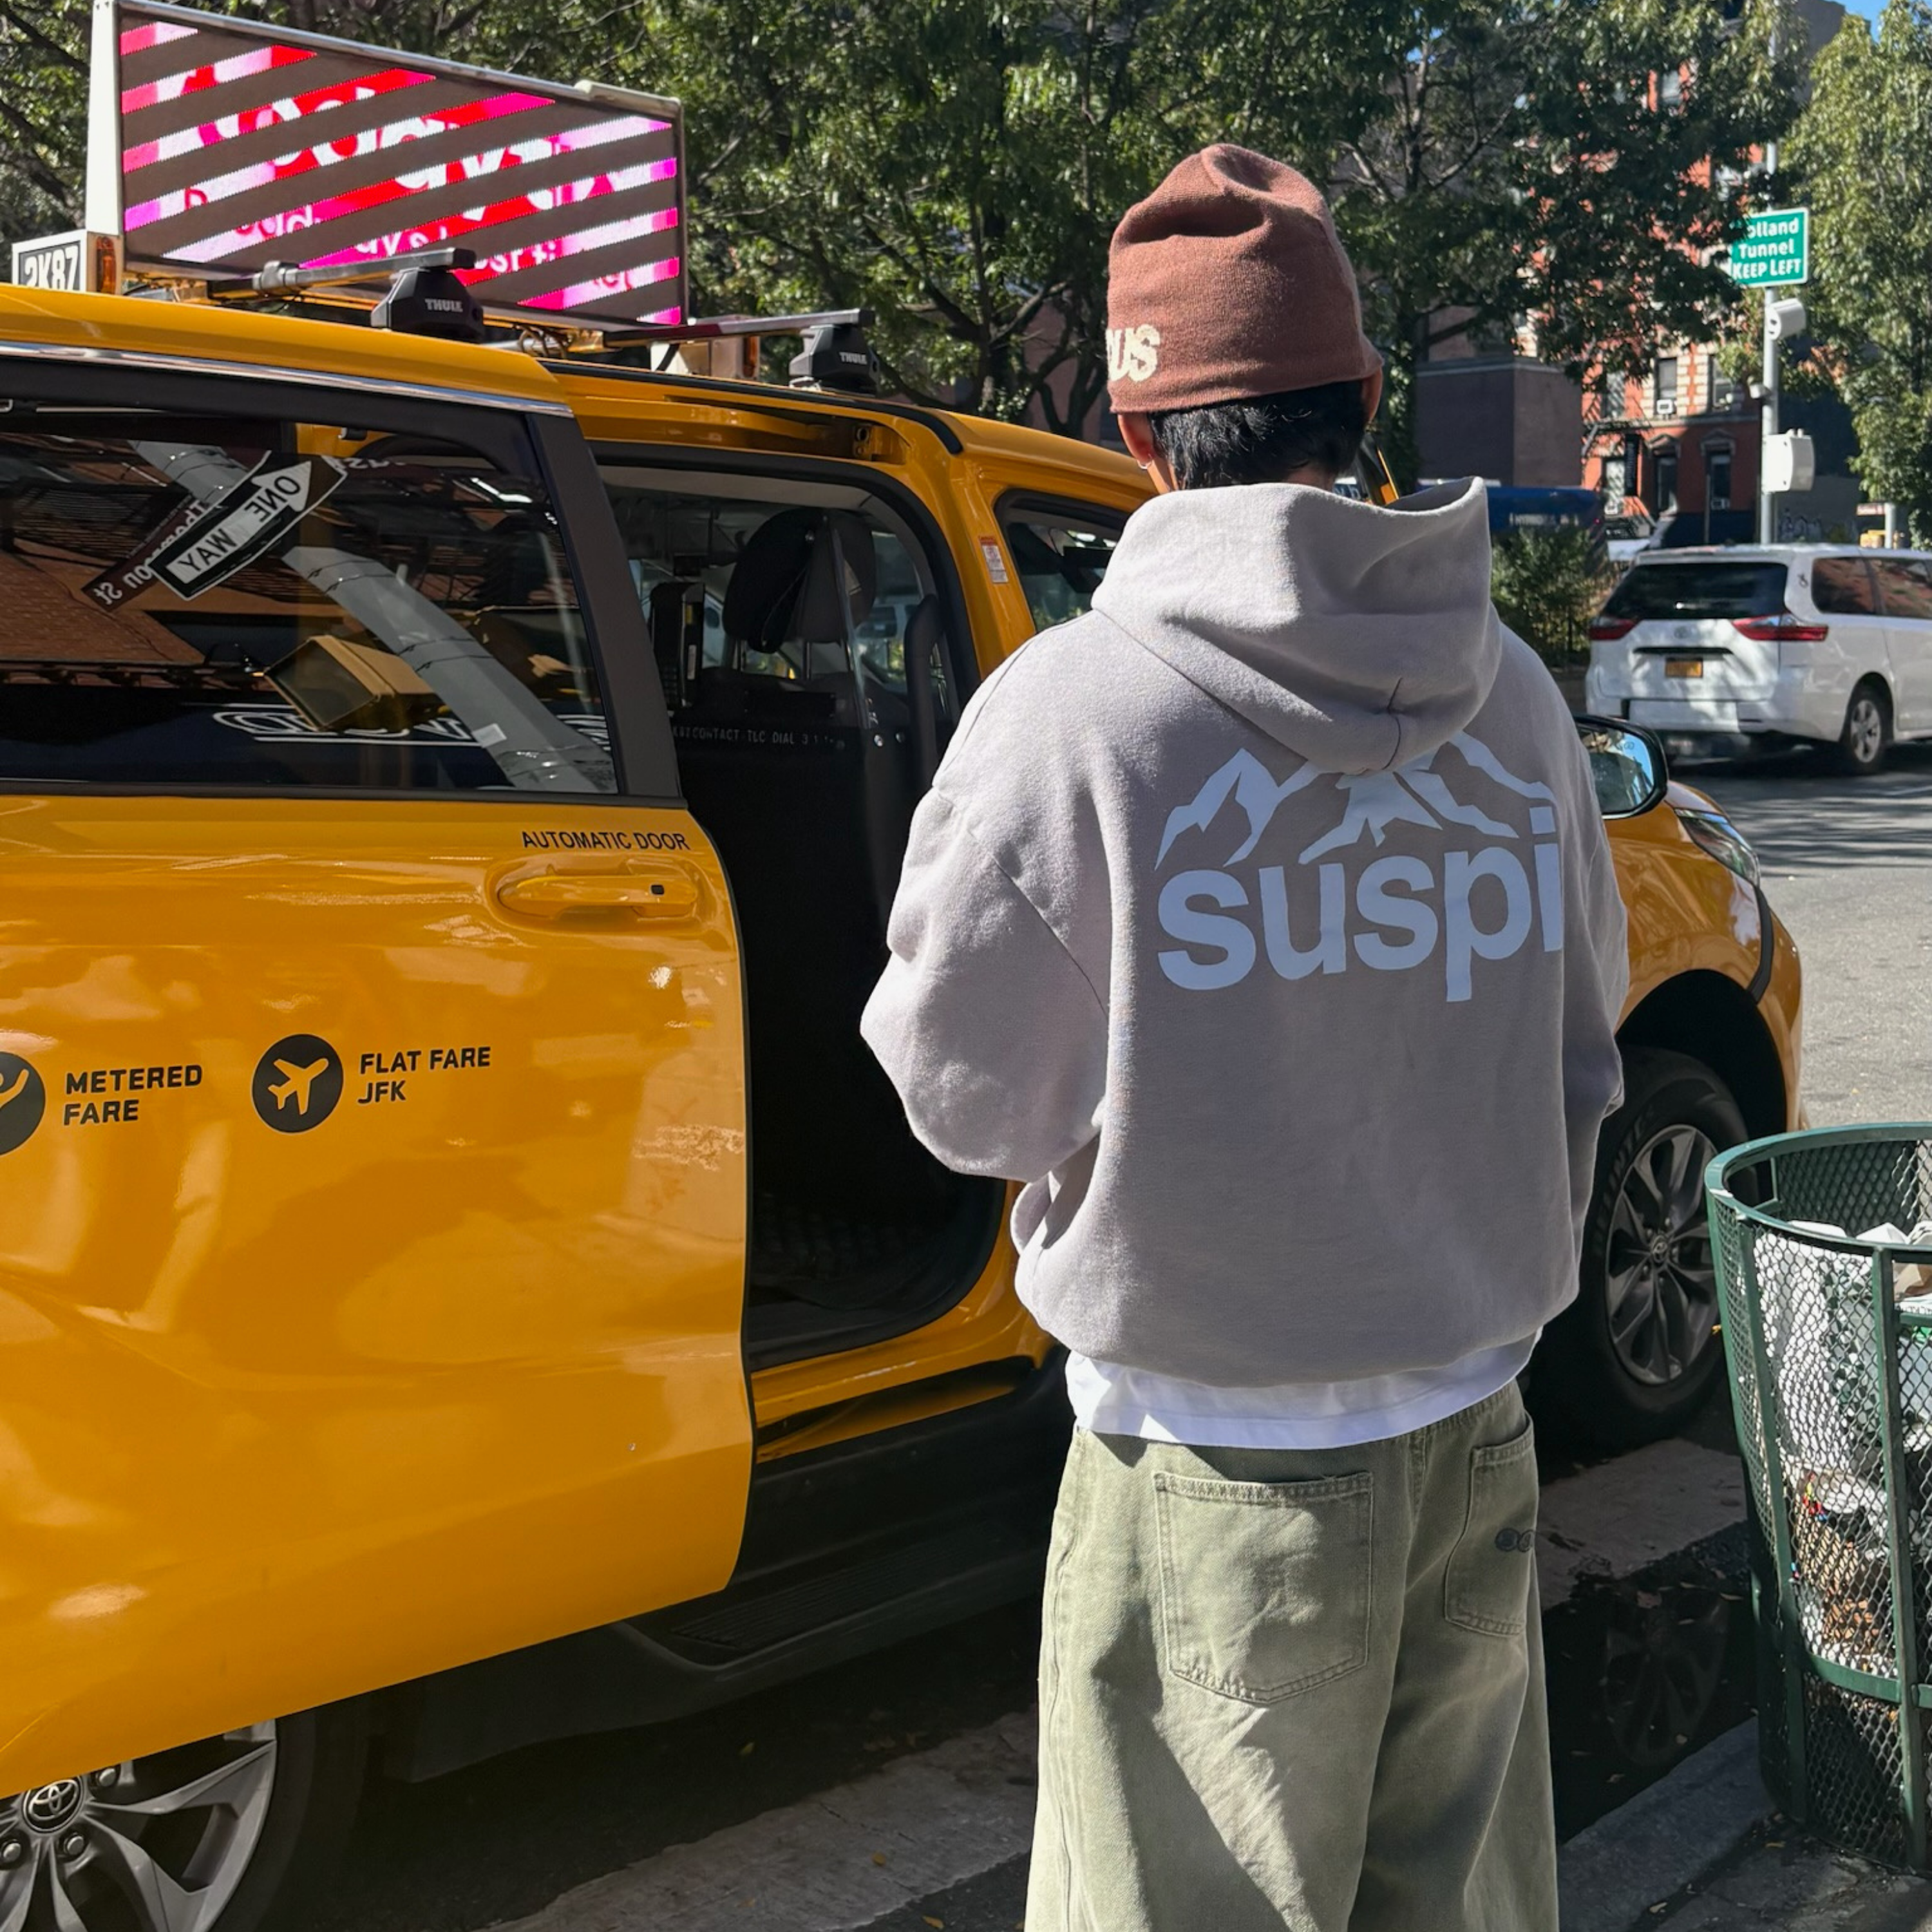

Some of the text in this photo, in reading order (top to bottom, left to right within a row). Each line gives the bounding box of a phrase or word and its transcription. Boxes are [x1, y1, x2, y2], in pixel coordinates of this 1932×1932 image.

[1747, 217, 1799, 238] olland
[1739, 238, 1794, 259] Tunnel
[25, 245, 79, 290] 2K87
[1732, 258, 1801, 280] KEEP LEFT
[425, 298, 463, 312] THULE
[839, 352, 867, 365] THULE
[1106, 324, 1160, 382] US
[748, 730, 766, 743] TLC
[772, 732, 795, 745] DIAL
[522, 831, 690, 850] AUTOMATIC DOOR
[1158, 806, 1563, 1002] suspi
[361, 1046, 491, 1074] FLAT FARE
[66, 1065, 202, 1095] METERED
[357, 1080, 406, 1104] JFK
[64, 1099, 139, 1125] FARE
